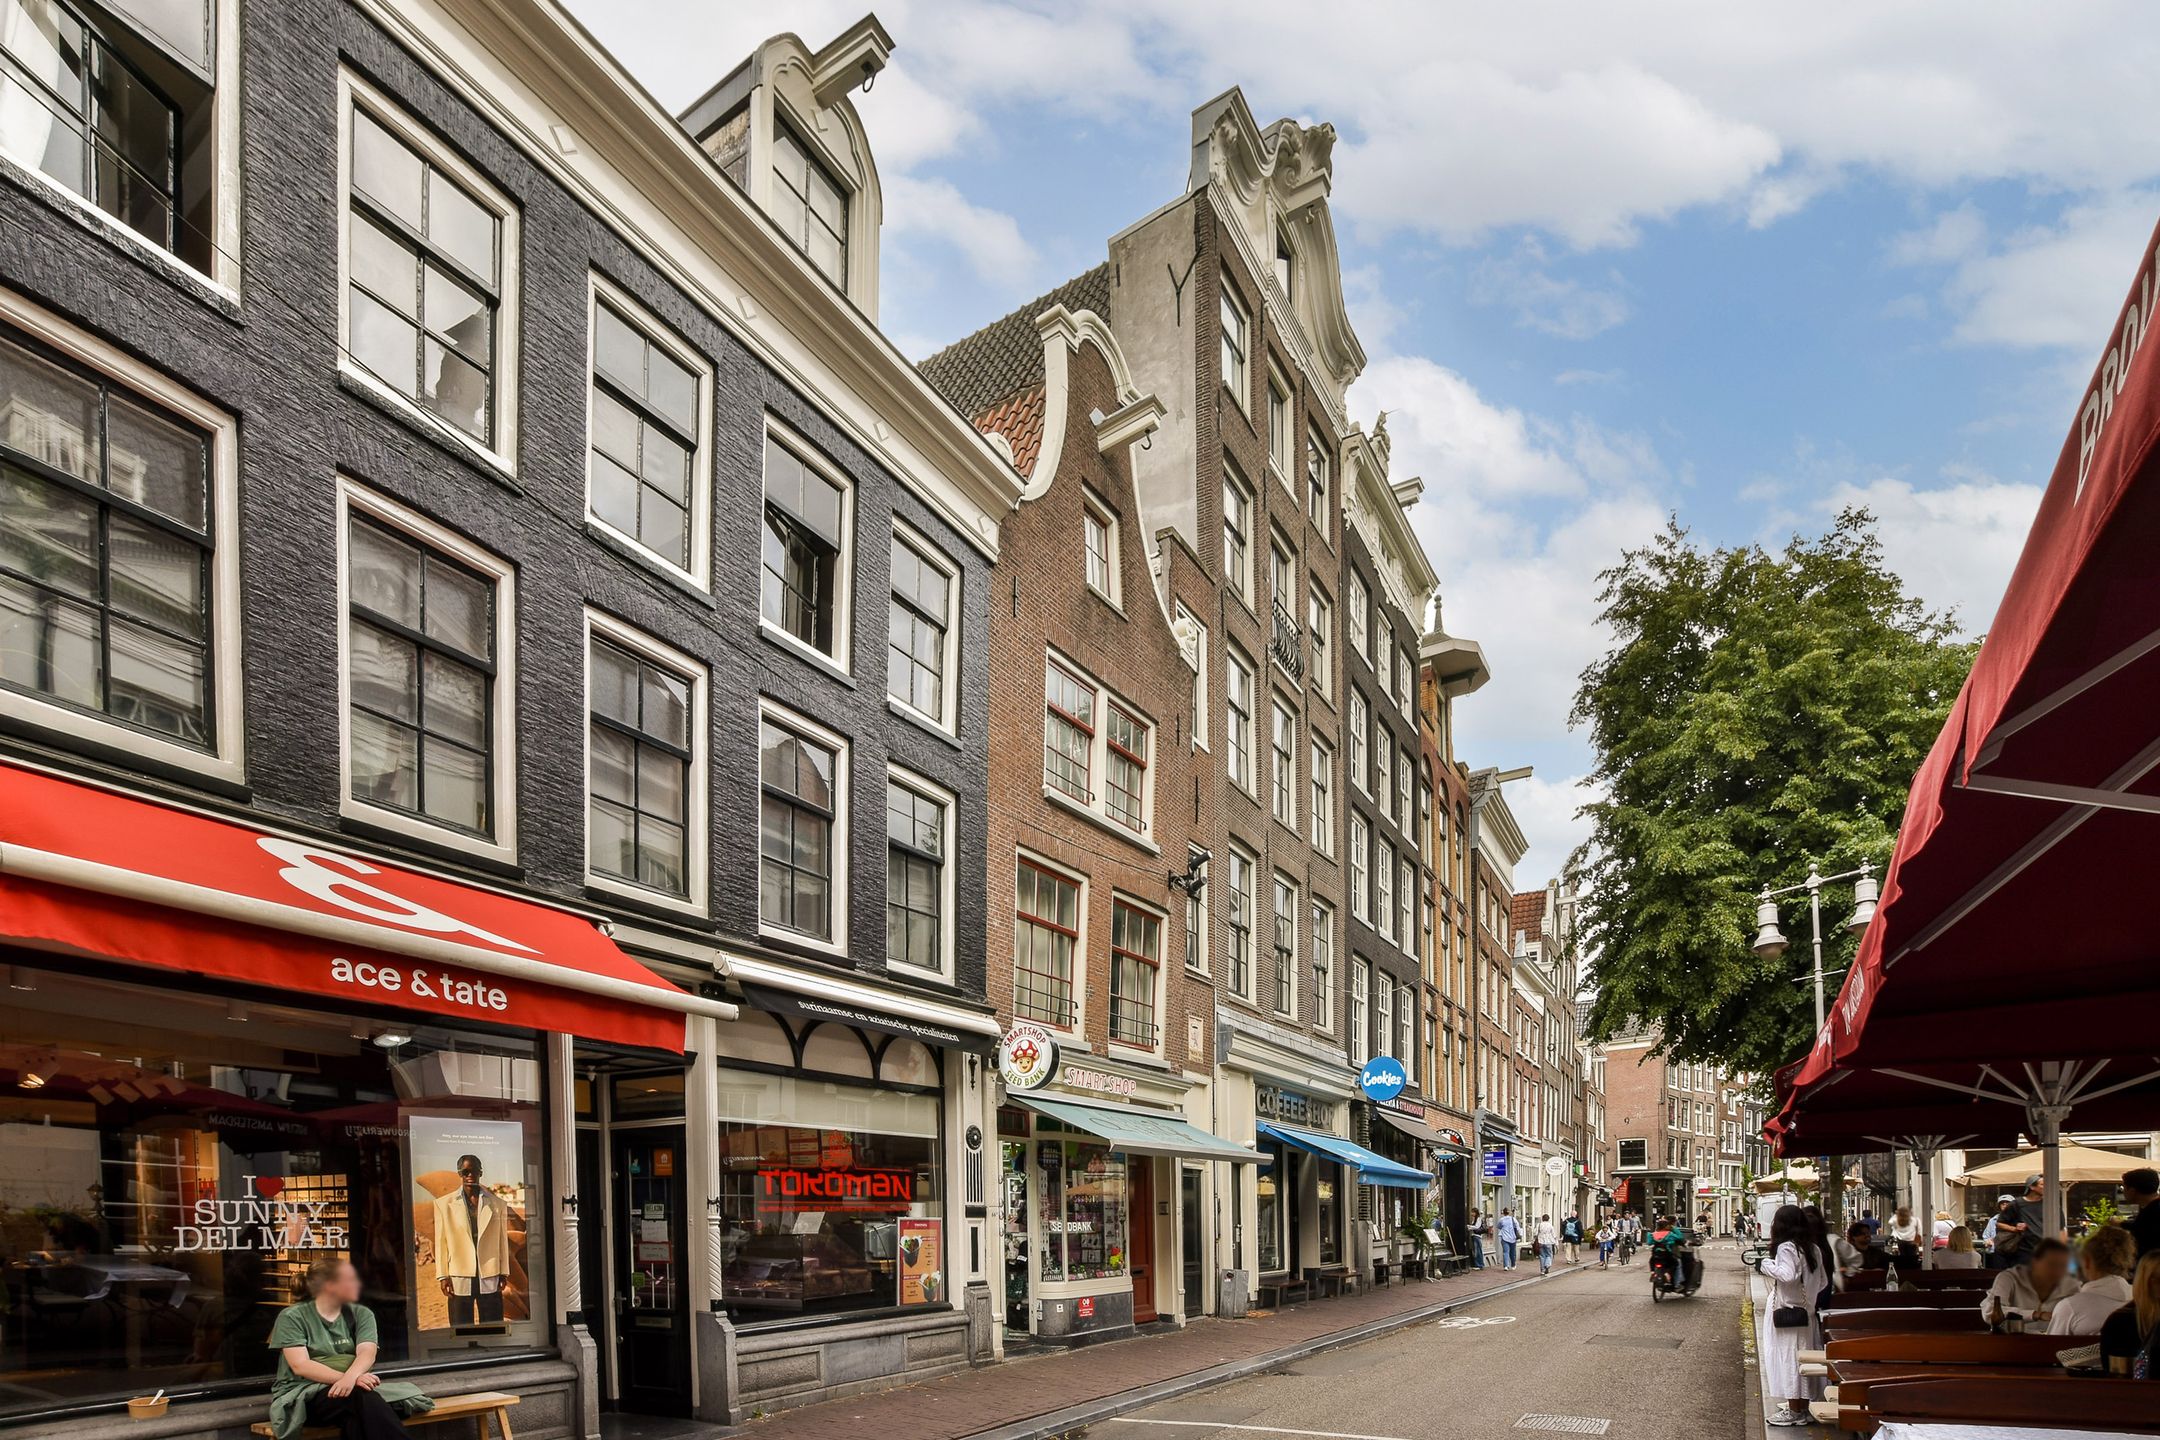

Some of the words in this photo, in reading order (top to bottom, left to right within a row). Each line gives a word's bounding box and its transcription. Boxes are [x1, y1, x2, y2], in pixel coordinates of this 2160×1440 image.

[331, 957, 402, 991] ace
[410, 969, 439, 998] &
[439, 973, 508, 1011] tate
[797, 1000, 854, 1020] surinaamse
[854, 1012, 868, 1022] en
[868, 1014, 910, 1032] aziatische
[910, 1024, 961, 1042] specialiteiten
[1003, 1026, 1047, 1049] SMARTSHOP
[1004, 1069, 1022, 1087] SEED
[1024, 1067, 1046, 1087] BANK
[1067, 1068, 1107, 1092] SMART
[1107, 1076, 1137, 1097] SHOP
[1362, 1070, 1402, 1087] Cookies
[1256, 1087, 1335, 1128] COFFEESHOP
[242, 1175, 258, 1198] I
[194, 1199, 329, 1225] SUNNY
[173, 1226, 252, 1251] DEL
[258, 1226, 349, 1251] MAR
